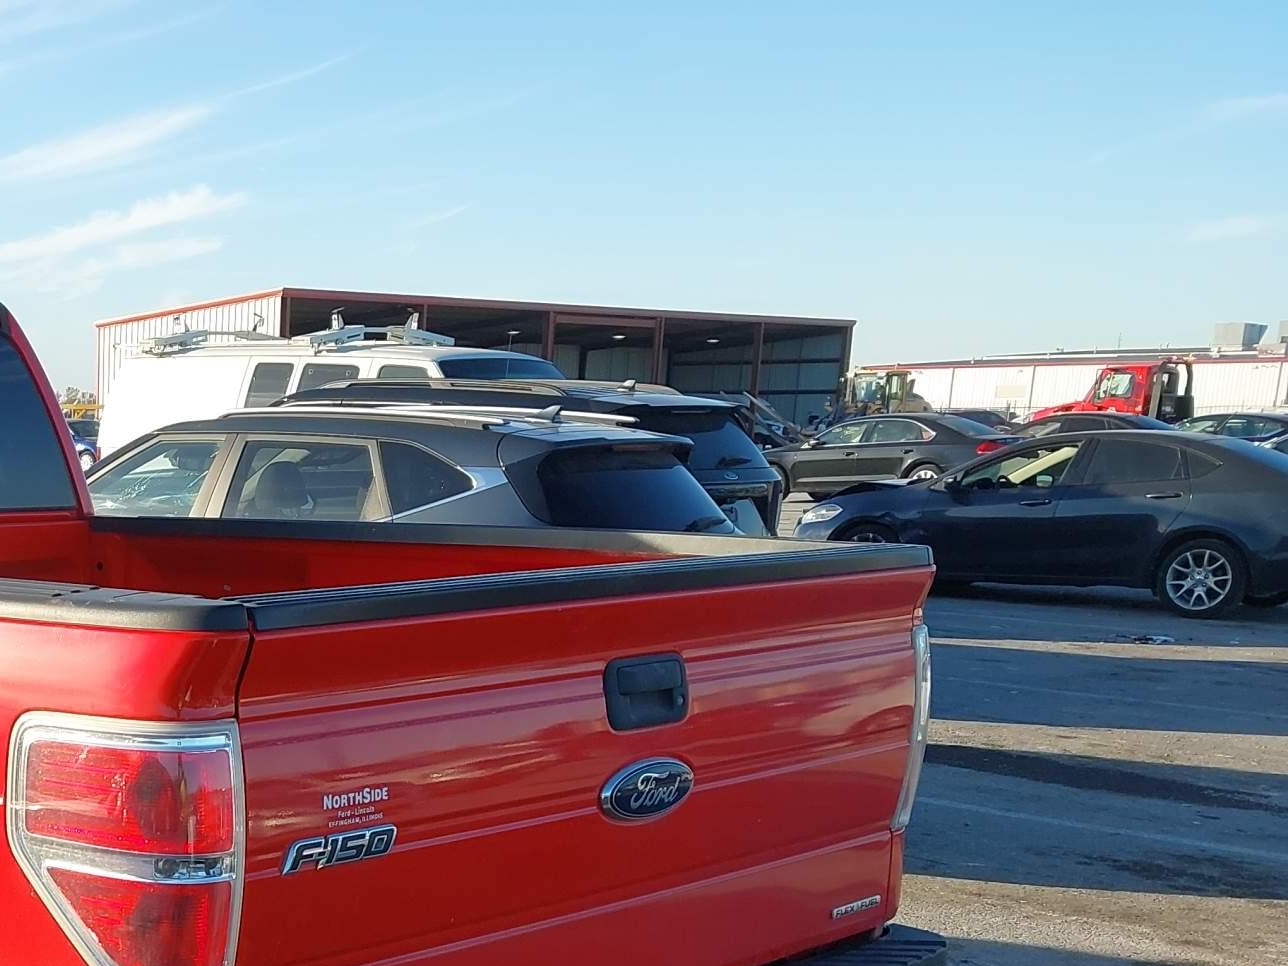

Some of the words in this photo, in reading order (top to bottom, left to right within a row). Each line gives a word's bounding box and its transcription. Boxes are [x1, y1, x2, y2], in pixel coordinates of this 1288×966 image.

[630, 771, 681, 810] Ford
[281, 824, 397, 876] F-150
[835, 905, 855, 918] FLEX
[860, 898, 879, 909] FUEL
